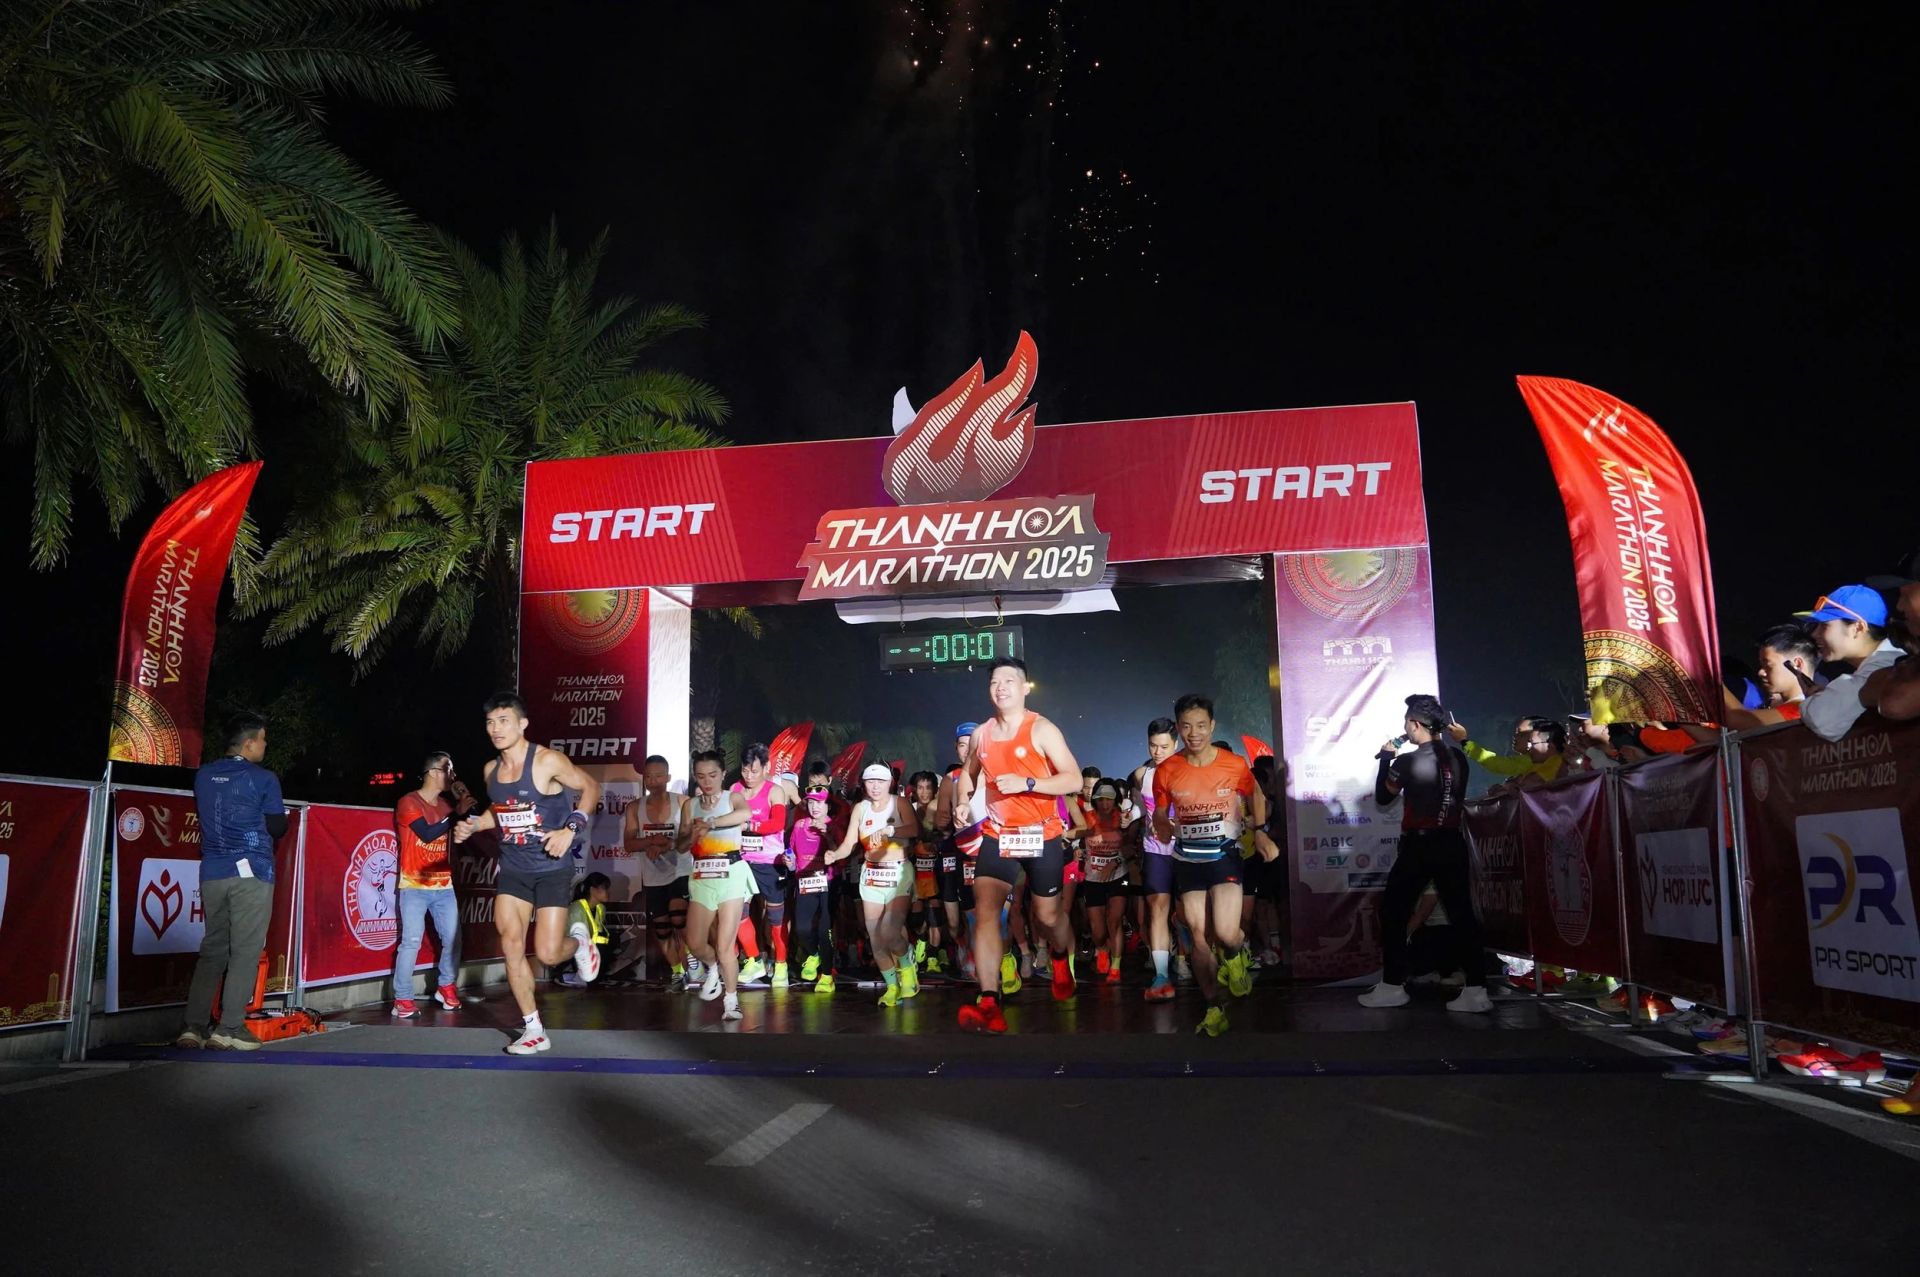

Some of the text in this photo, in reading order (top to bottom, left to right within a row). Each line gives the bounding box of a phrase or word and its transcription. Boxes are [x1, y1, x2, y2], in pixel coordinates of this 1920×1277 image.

[1200, 462, 1392, 504] START
[550, 503, 715, 543] START
[826, 511, 985, 549] THANH
[1628, 464, 1671, 562] THANH
[1597, 458, 1651, 632] MARATHON 2025
[811, 545, 1095, 588] MARATHON 2025
[169, 547, 200, 631] THANH
[138, 539, 182, 687] MARATHON 2025
[552, 690, 623, 702] MARATHON
[556, 676, 599, 686] THANH
[570, 707, 606, 726] 2025
[550, 737, 637, 757] START
[1801, 741, 1852, 767] THANH
[1800, 767, 1869, 793] MARATHON
[1871, 761, 1897, 787] 2025
[1191, 824, 1220, 834] 97515
[348, 854, 364, 916] THANH
[1815, 946, 1917, 980] PR SPORT
